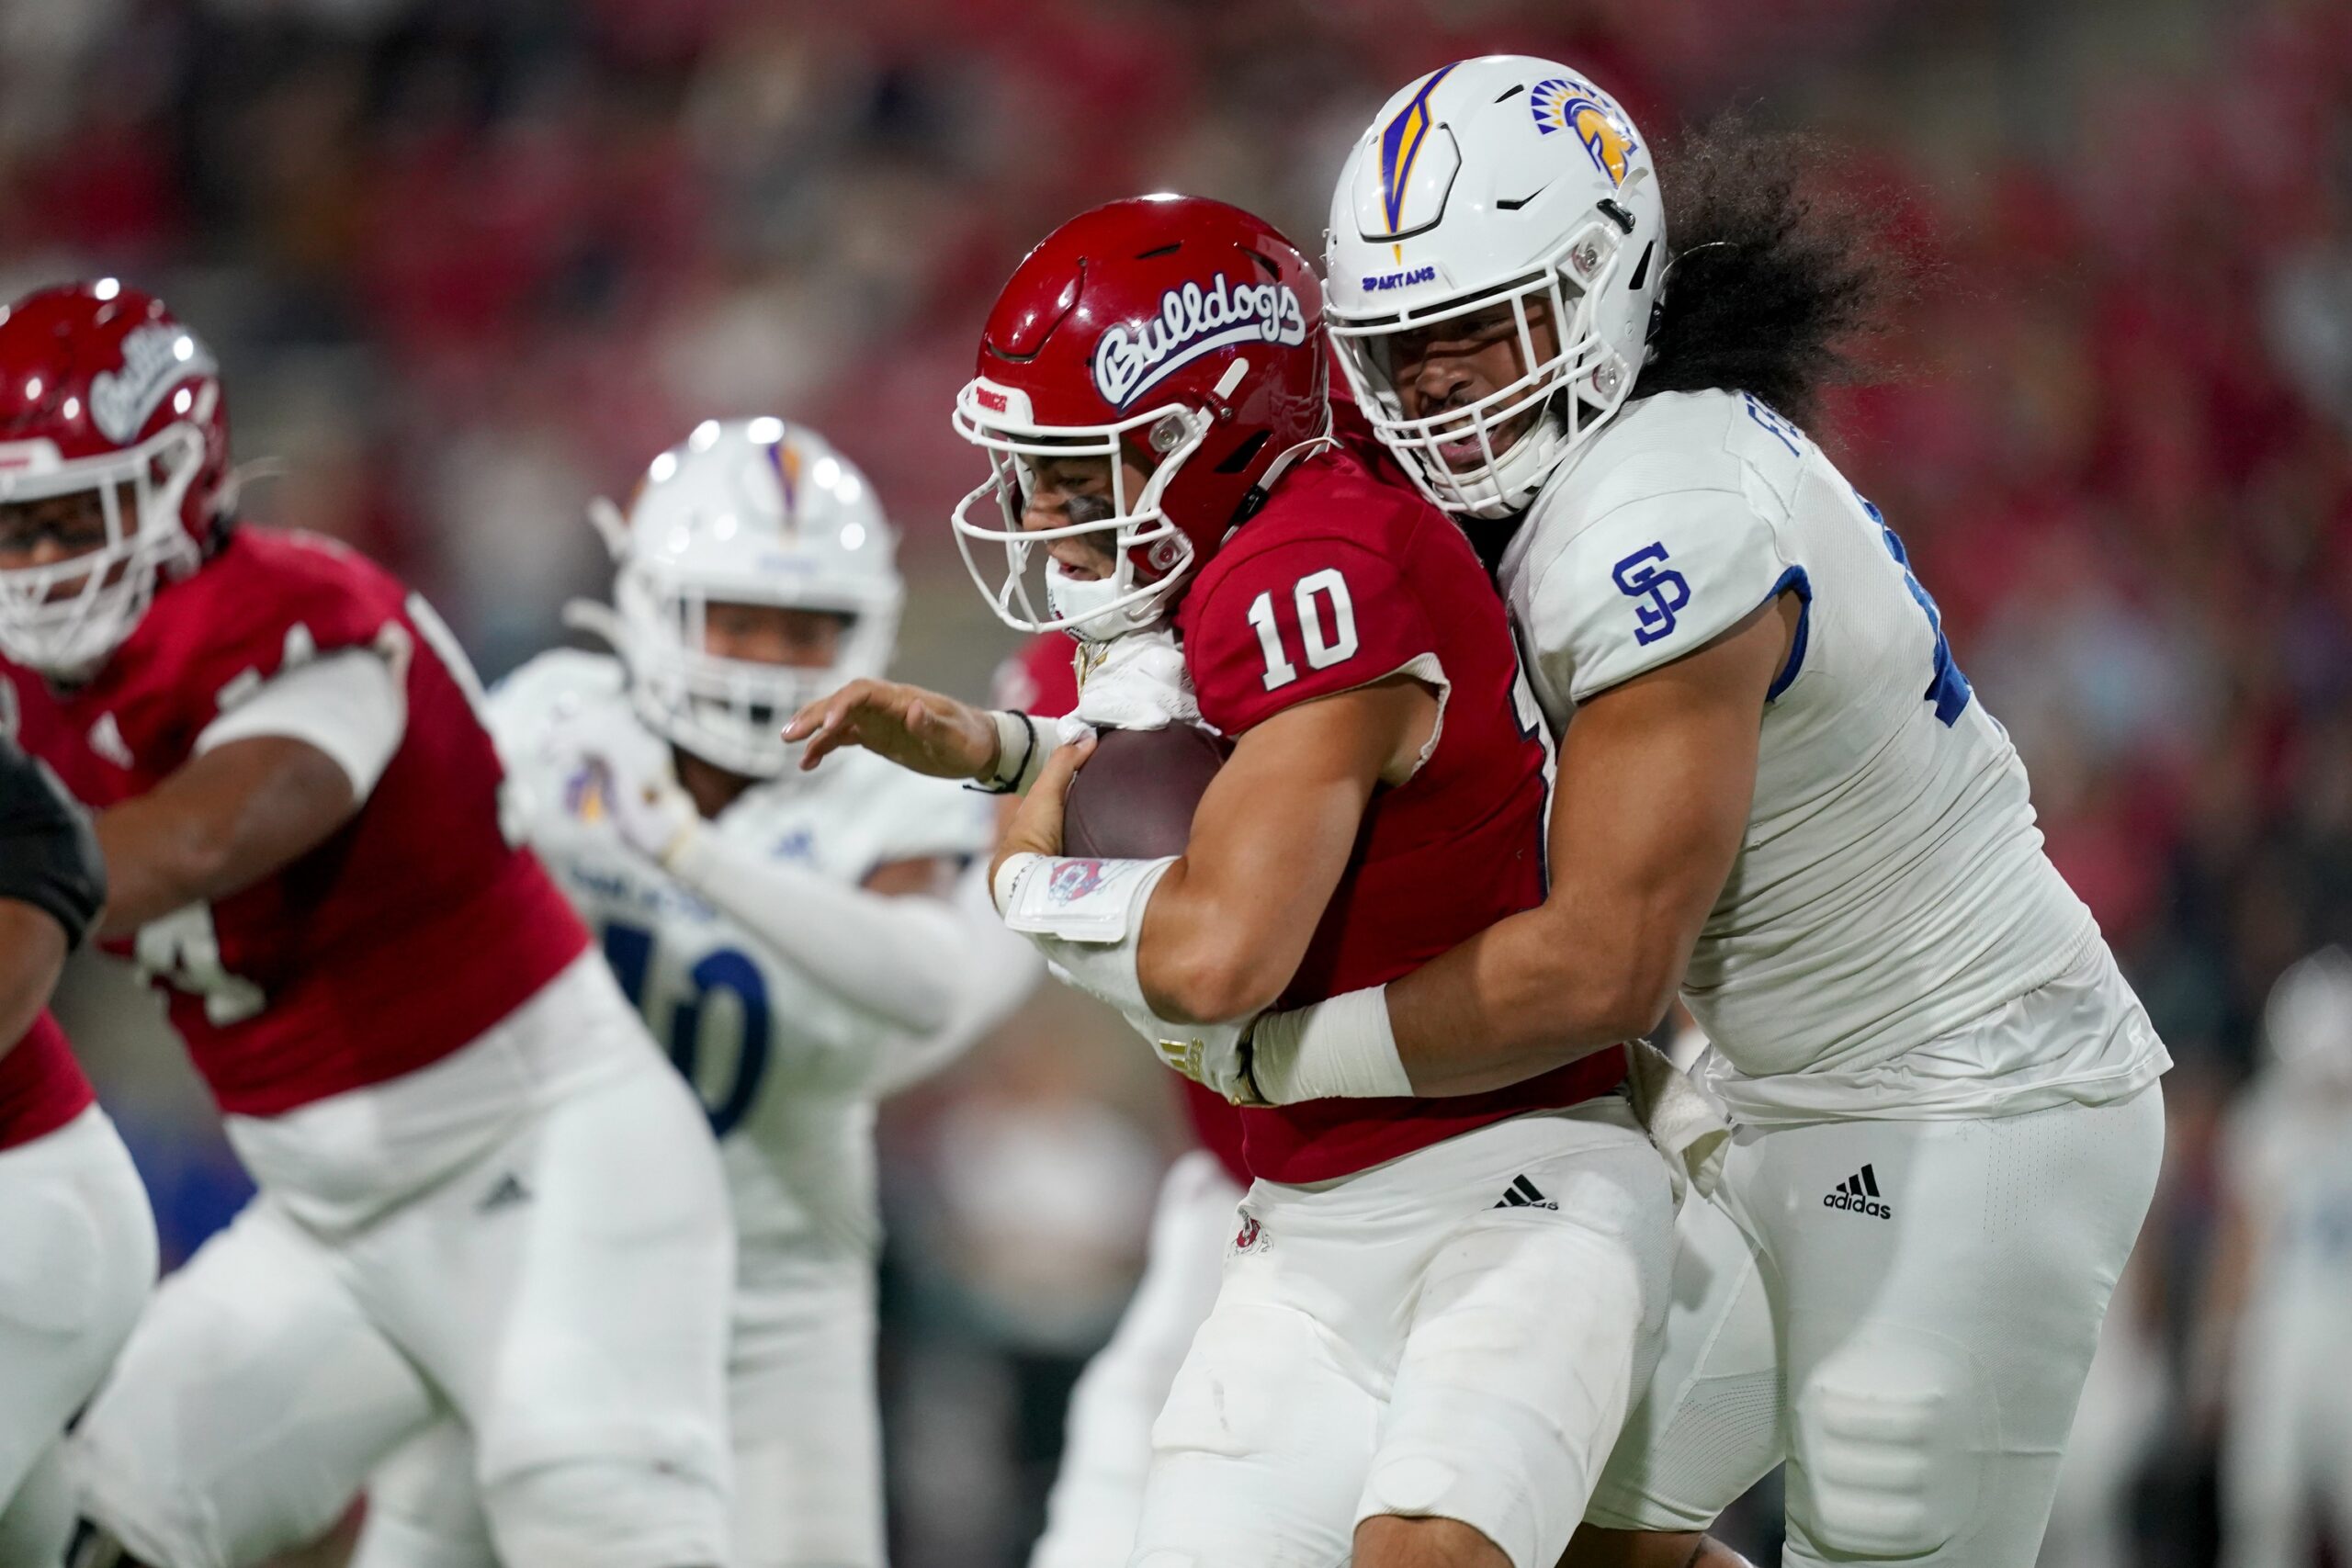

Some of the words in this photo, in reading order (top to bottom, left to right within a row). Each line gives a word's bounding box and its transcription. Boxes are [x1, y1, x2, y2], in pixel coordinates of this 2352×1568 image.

[1363, 266, 1435, 292] SPARTANS
[1094, 273, 1306, 406] Bulldogs
[1247, 567, 1360, 693] 10
[1824, 1193, 1891, 1220] adidas
